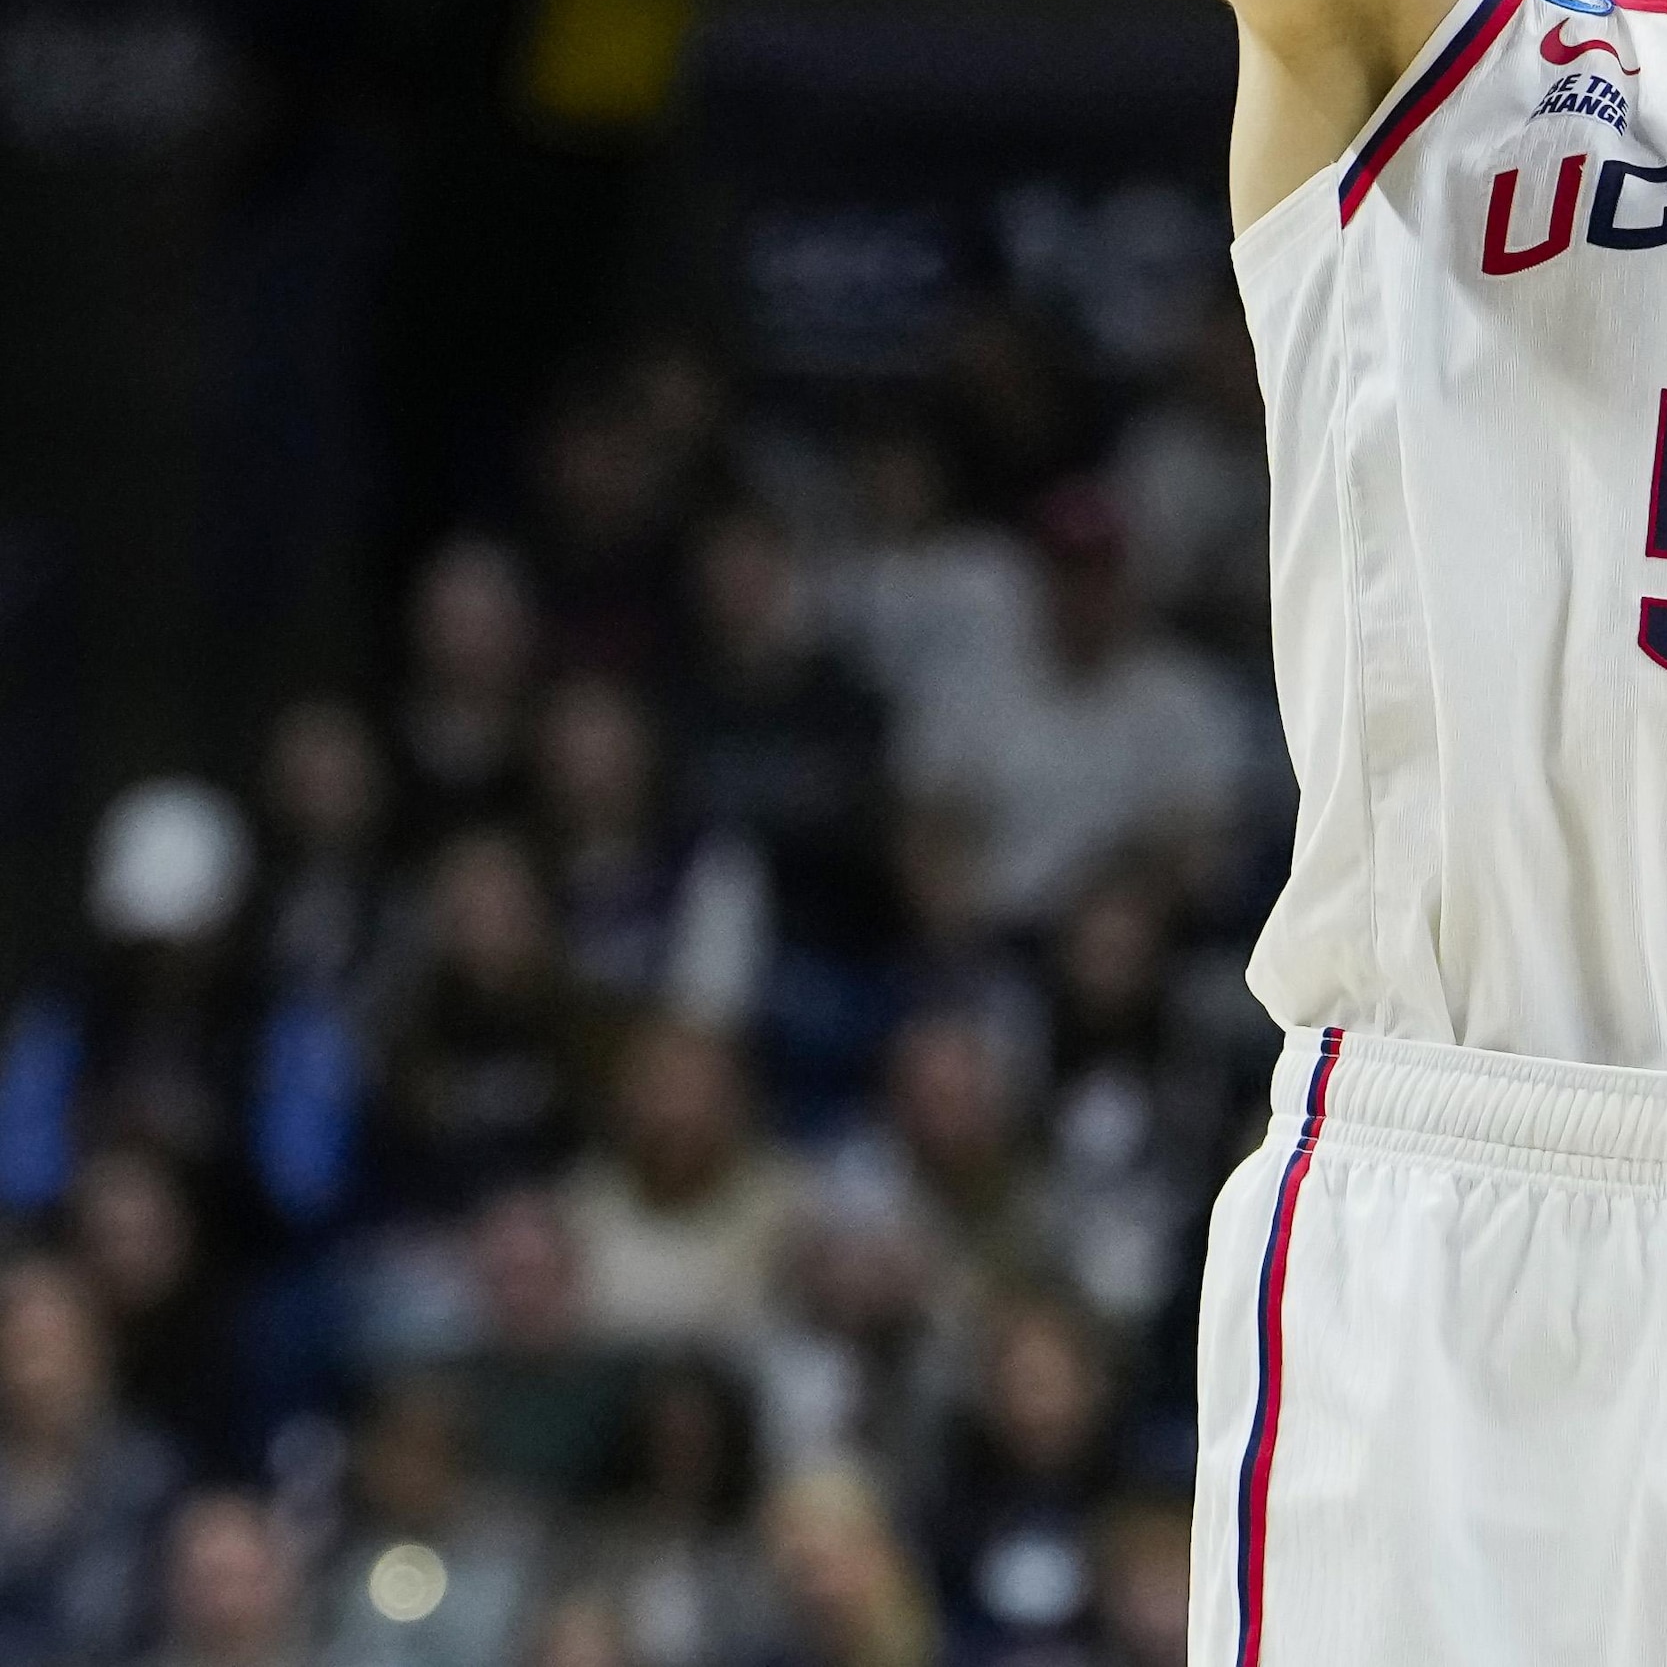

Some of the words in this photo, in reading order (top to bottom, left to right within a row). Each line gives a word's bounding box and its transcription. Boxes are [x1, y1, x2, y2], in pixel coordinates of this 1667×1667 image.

[1529, 93, 1629, 137] CHANGE
[1545, 73, 1581, 98] BE
[1586, 75, 1630, 116] THE
